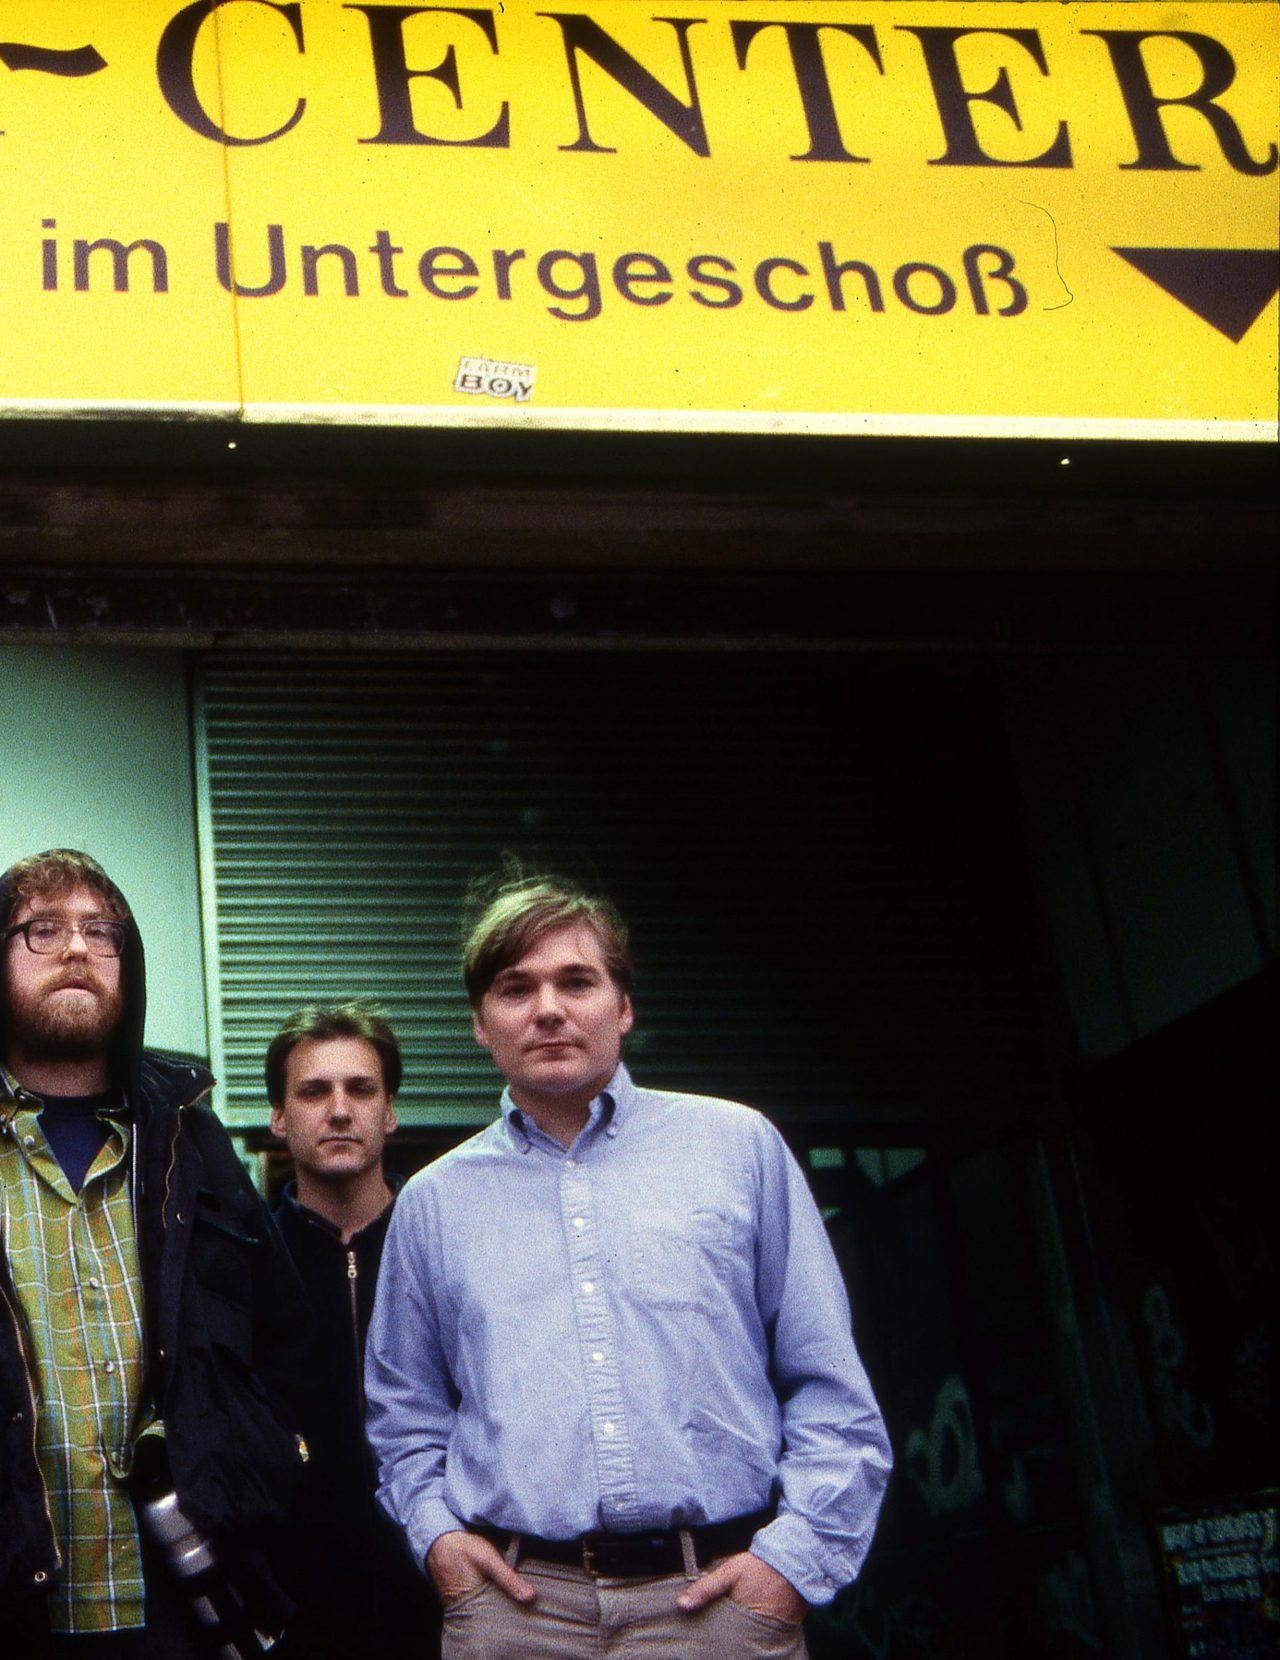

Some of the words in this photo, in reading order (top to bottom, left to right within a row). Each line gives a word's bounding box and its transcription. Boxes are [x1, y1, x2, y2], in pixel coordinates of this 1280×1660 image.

[41, 218, 168, 295] im
[214, 221, 1028, 321] Untergeschoß
[460, 373, 532, 397] BOY
